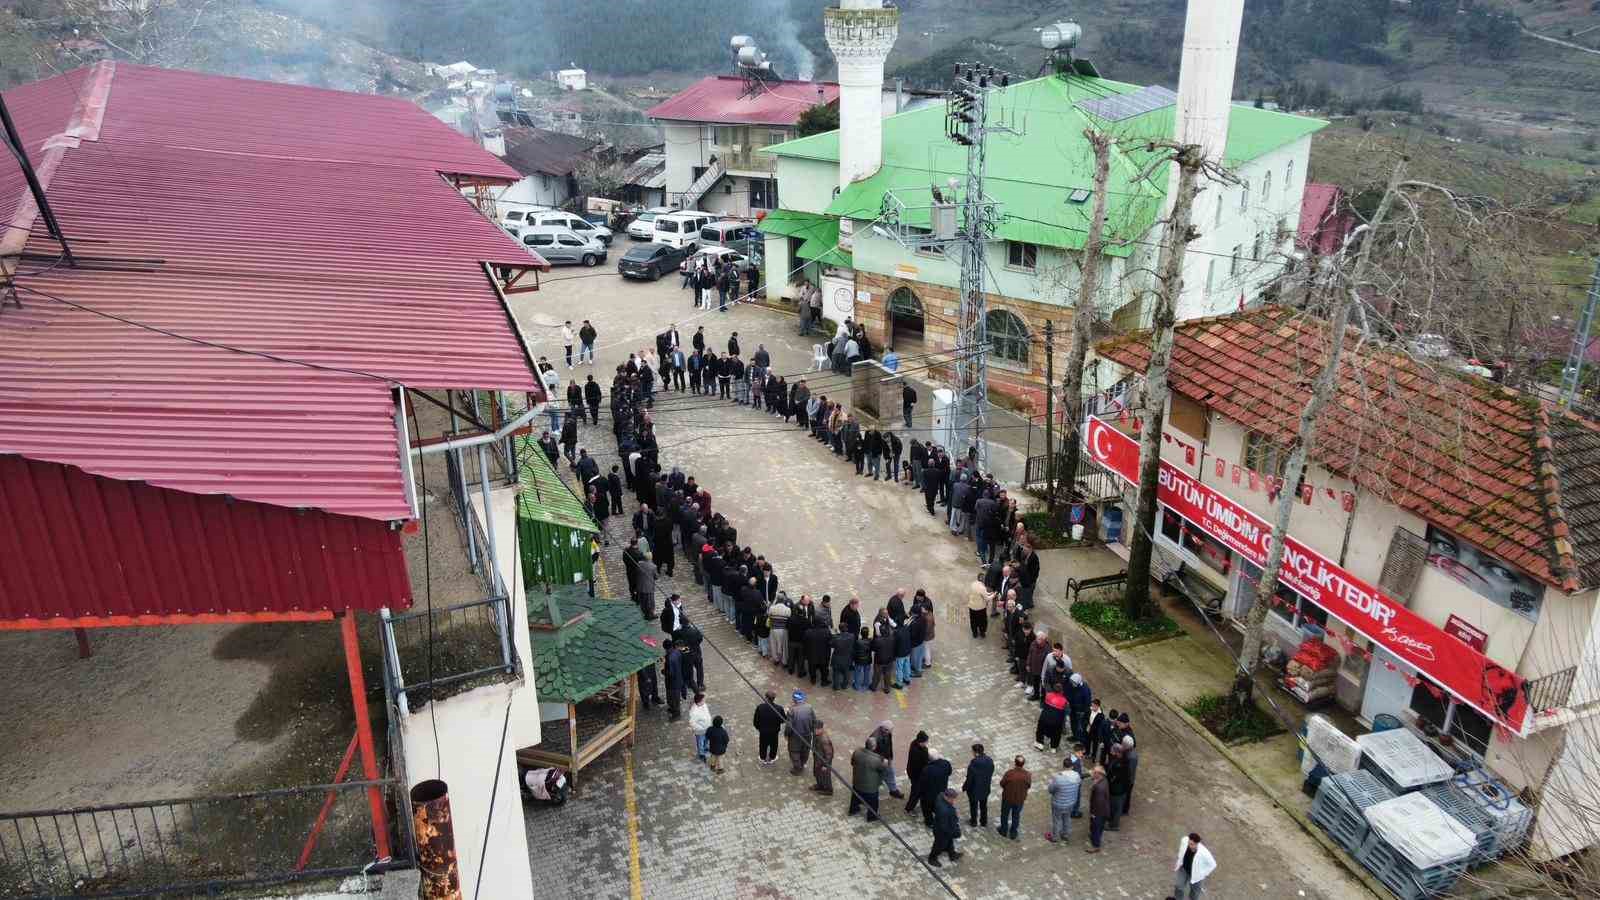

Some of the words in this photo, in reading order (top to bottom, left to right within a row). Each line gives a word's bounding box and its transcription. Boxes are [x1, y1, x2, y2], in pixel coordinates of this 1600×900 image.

[1158, 467, 1205, 510] BÜTÜN
[1206, 494, 1259, 545] ÜMİDİM
[1262, 533, 1396, 626] GNÇLİKTEDİR'
